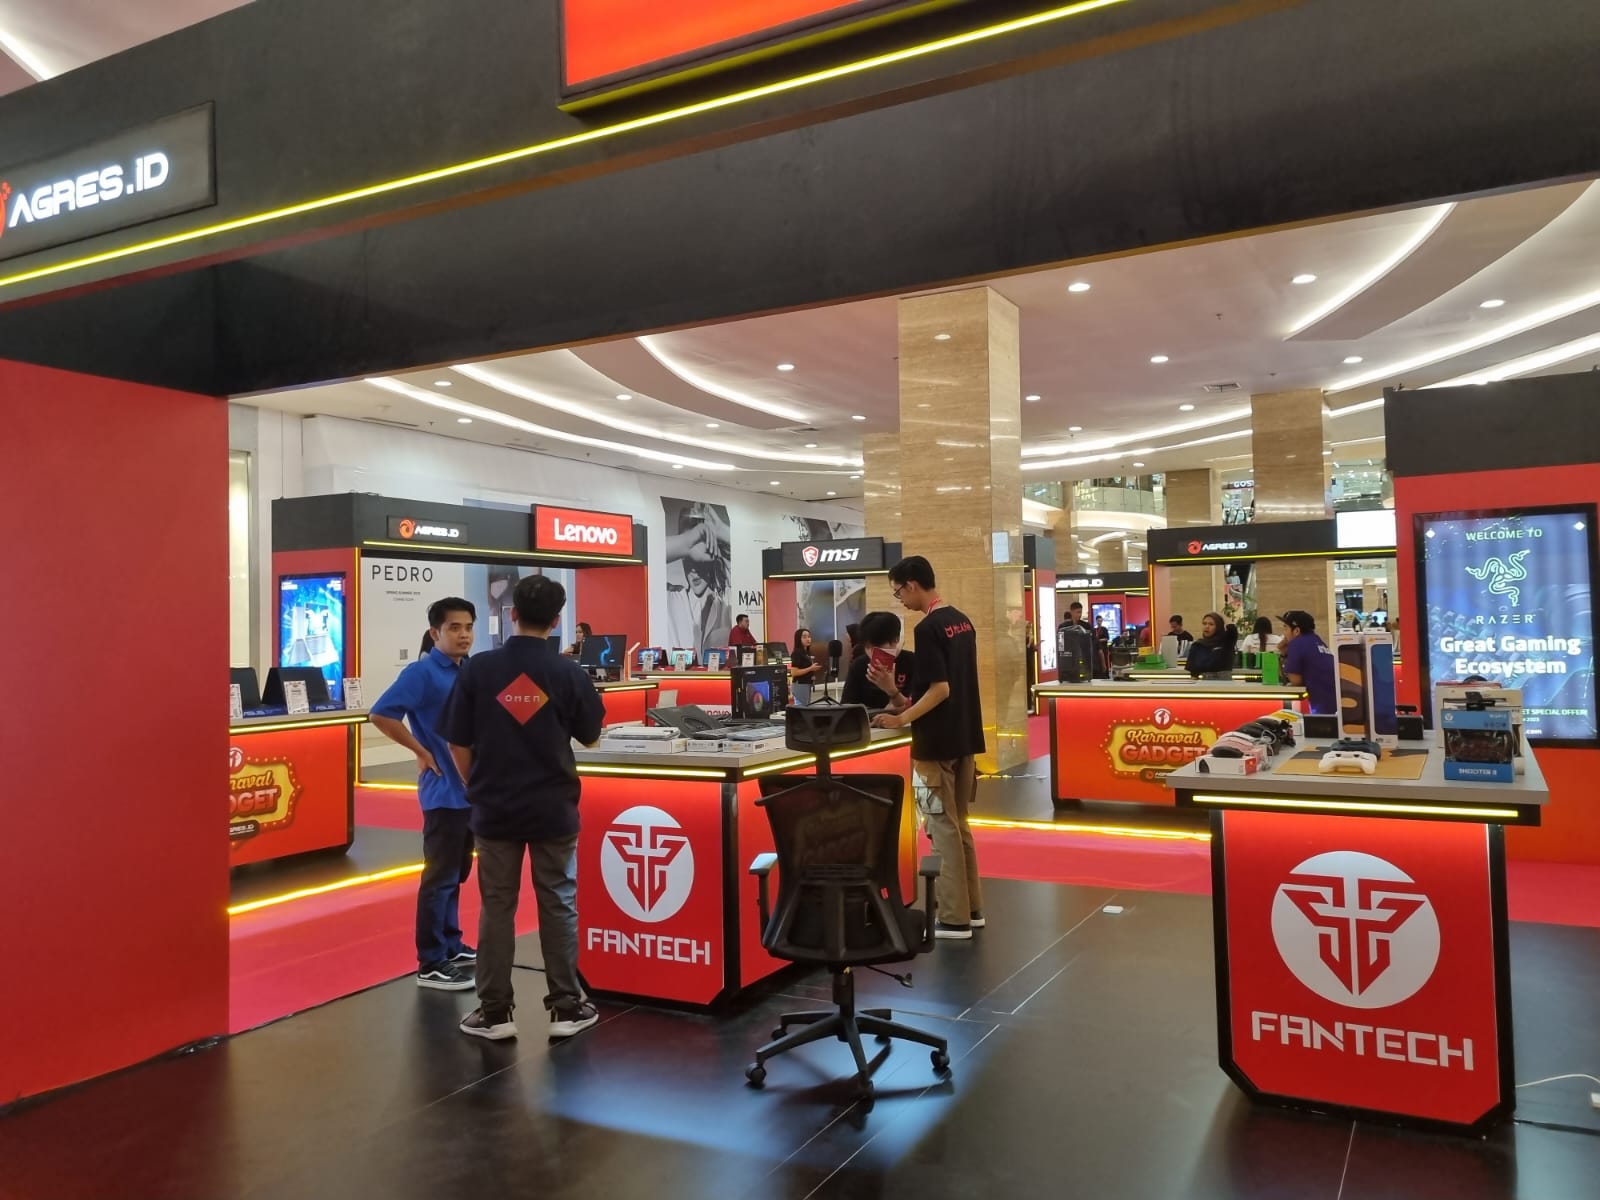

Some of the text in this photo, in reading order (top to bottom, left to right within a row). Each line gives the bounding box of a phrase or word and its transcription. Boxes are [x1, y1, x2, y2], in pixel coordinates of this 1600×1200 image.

[9, 152, 169, 228] AGRES.ID
[554, 518, 618, 545] Lenovo
[1466, 528, 1543, 541] WELCOME TO
[820, 548, 860, 562] msi
[372, 564, 433, 582] PEDRO
[1476, 614, 1533, 625] RAZER
[1440, 635, 1582, 655] Great Gaming
[1455, 657, 1567, 678] Ecosystem
[1127, 730, 1200, 745] Karnaval
[587, 928, 711, 965] FANTECH
[1252, 1011, 1474, 1071] FANTECH
